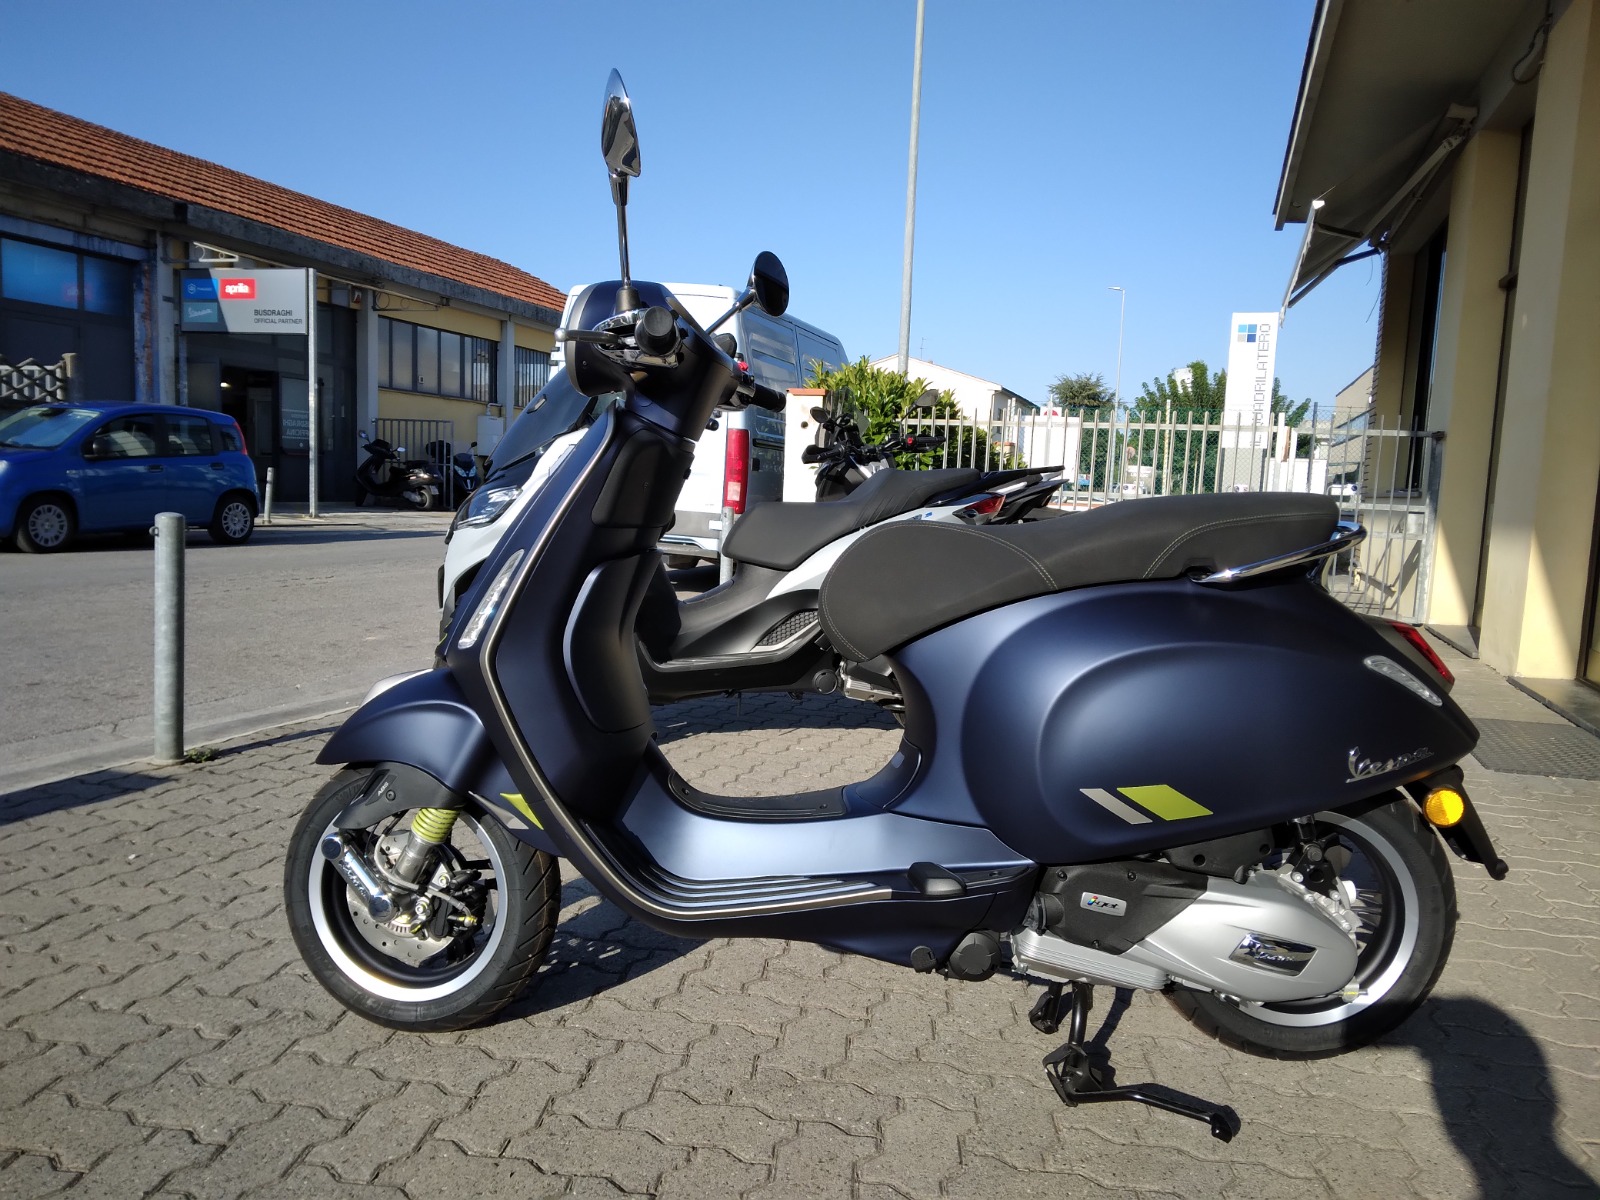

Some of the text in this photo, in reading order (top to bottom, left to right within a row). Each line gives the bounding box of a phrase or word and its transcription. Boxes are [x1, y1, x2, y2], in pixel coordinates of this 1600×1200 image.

[225, 283, 249, 295] aprilia
[254, 309, 293, 317] BUSDRAGHI
[1346, 746, 1434, 783] Vespa
